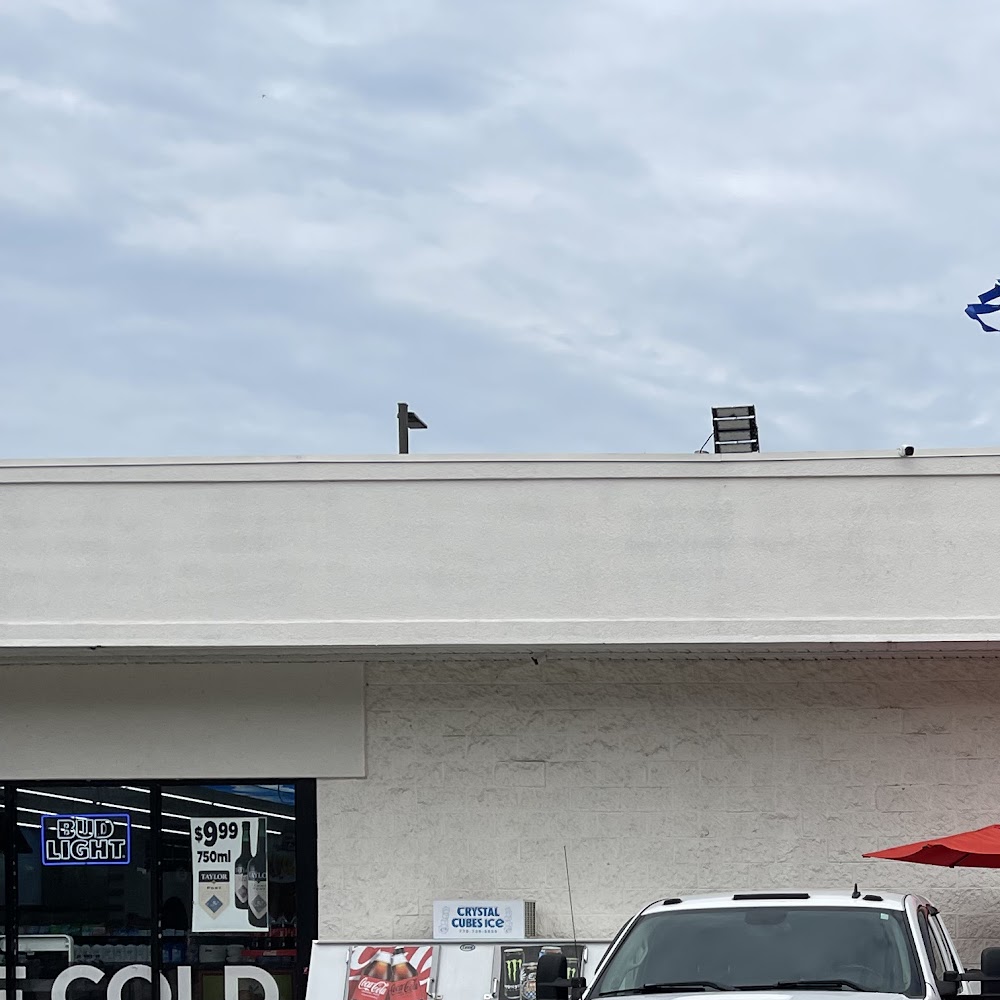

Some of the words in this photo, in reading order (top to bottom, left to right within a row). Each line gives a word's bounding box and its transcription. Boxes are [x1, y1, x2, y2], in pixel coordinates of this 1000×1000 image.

[56, 818, 115, 840] BUD
[46, 838, 126, 861] LIGHT
[197, 849, 231, 864] 750ml
[200, 873, 229, 881] TAYLOR
[456, 906, 500, 917] CRYSTAL
[451, 918, 483, 928] CUBES
